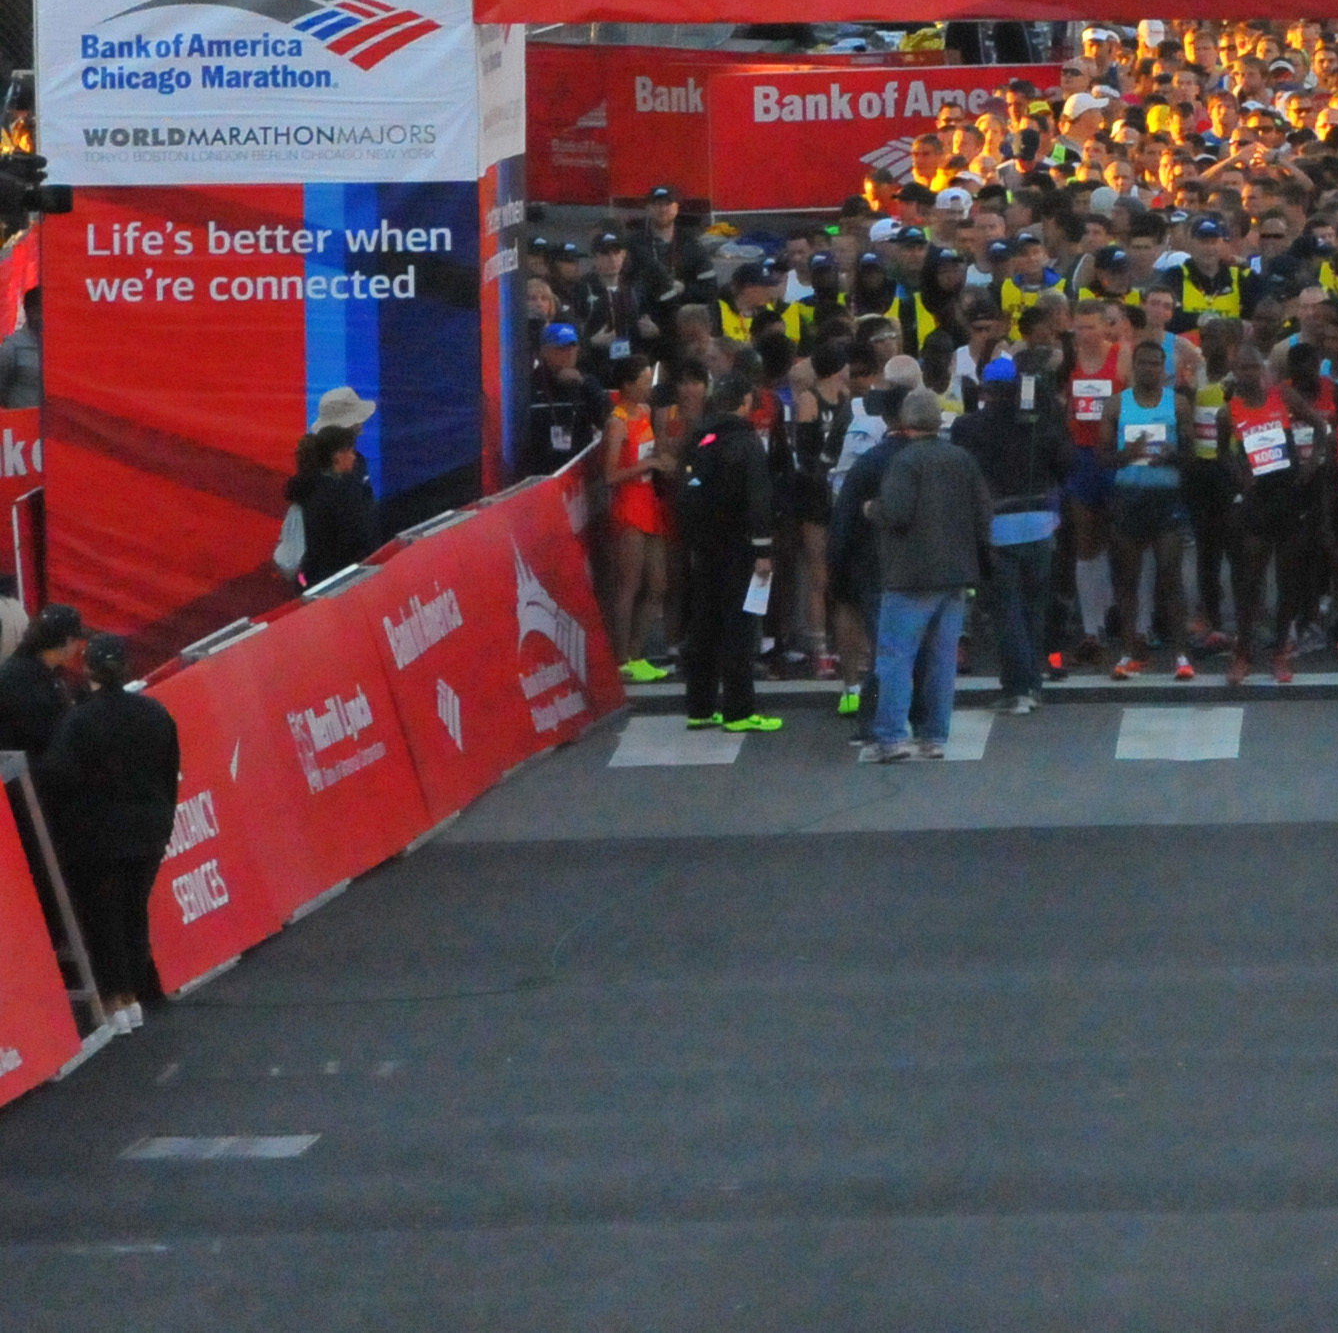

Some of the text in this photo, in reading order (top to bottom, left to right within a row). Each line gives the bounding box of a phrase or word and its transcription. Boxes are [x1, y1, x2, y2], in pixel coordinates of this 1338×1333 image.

[81, 33, 303, 59] Bank of America
[81, 66, 191, 94] Chicago
[634, 76, 705, 113] Bank
[753, 82, 900, 123] Bank of
[83, 124, 436, 147] WORLDMARATHONMAJORS
[84, 148, 436, 163] TOKYO BOSTON LONDON BERLIN CHICAGO NEW YORK
[86, 219, 453, 256] Life's better when
[86, 265, 416, 302] we're connected
[172, 858, 230, 925] SERVICES
